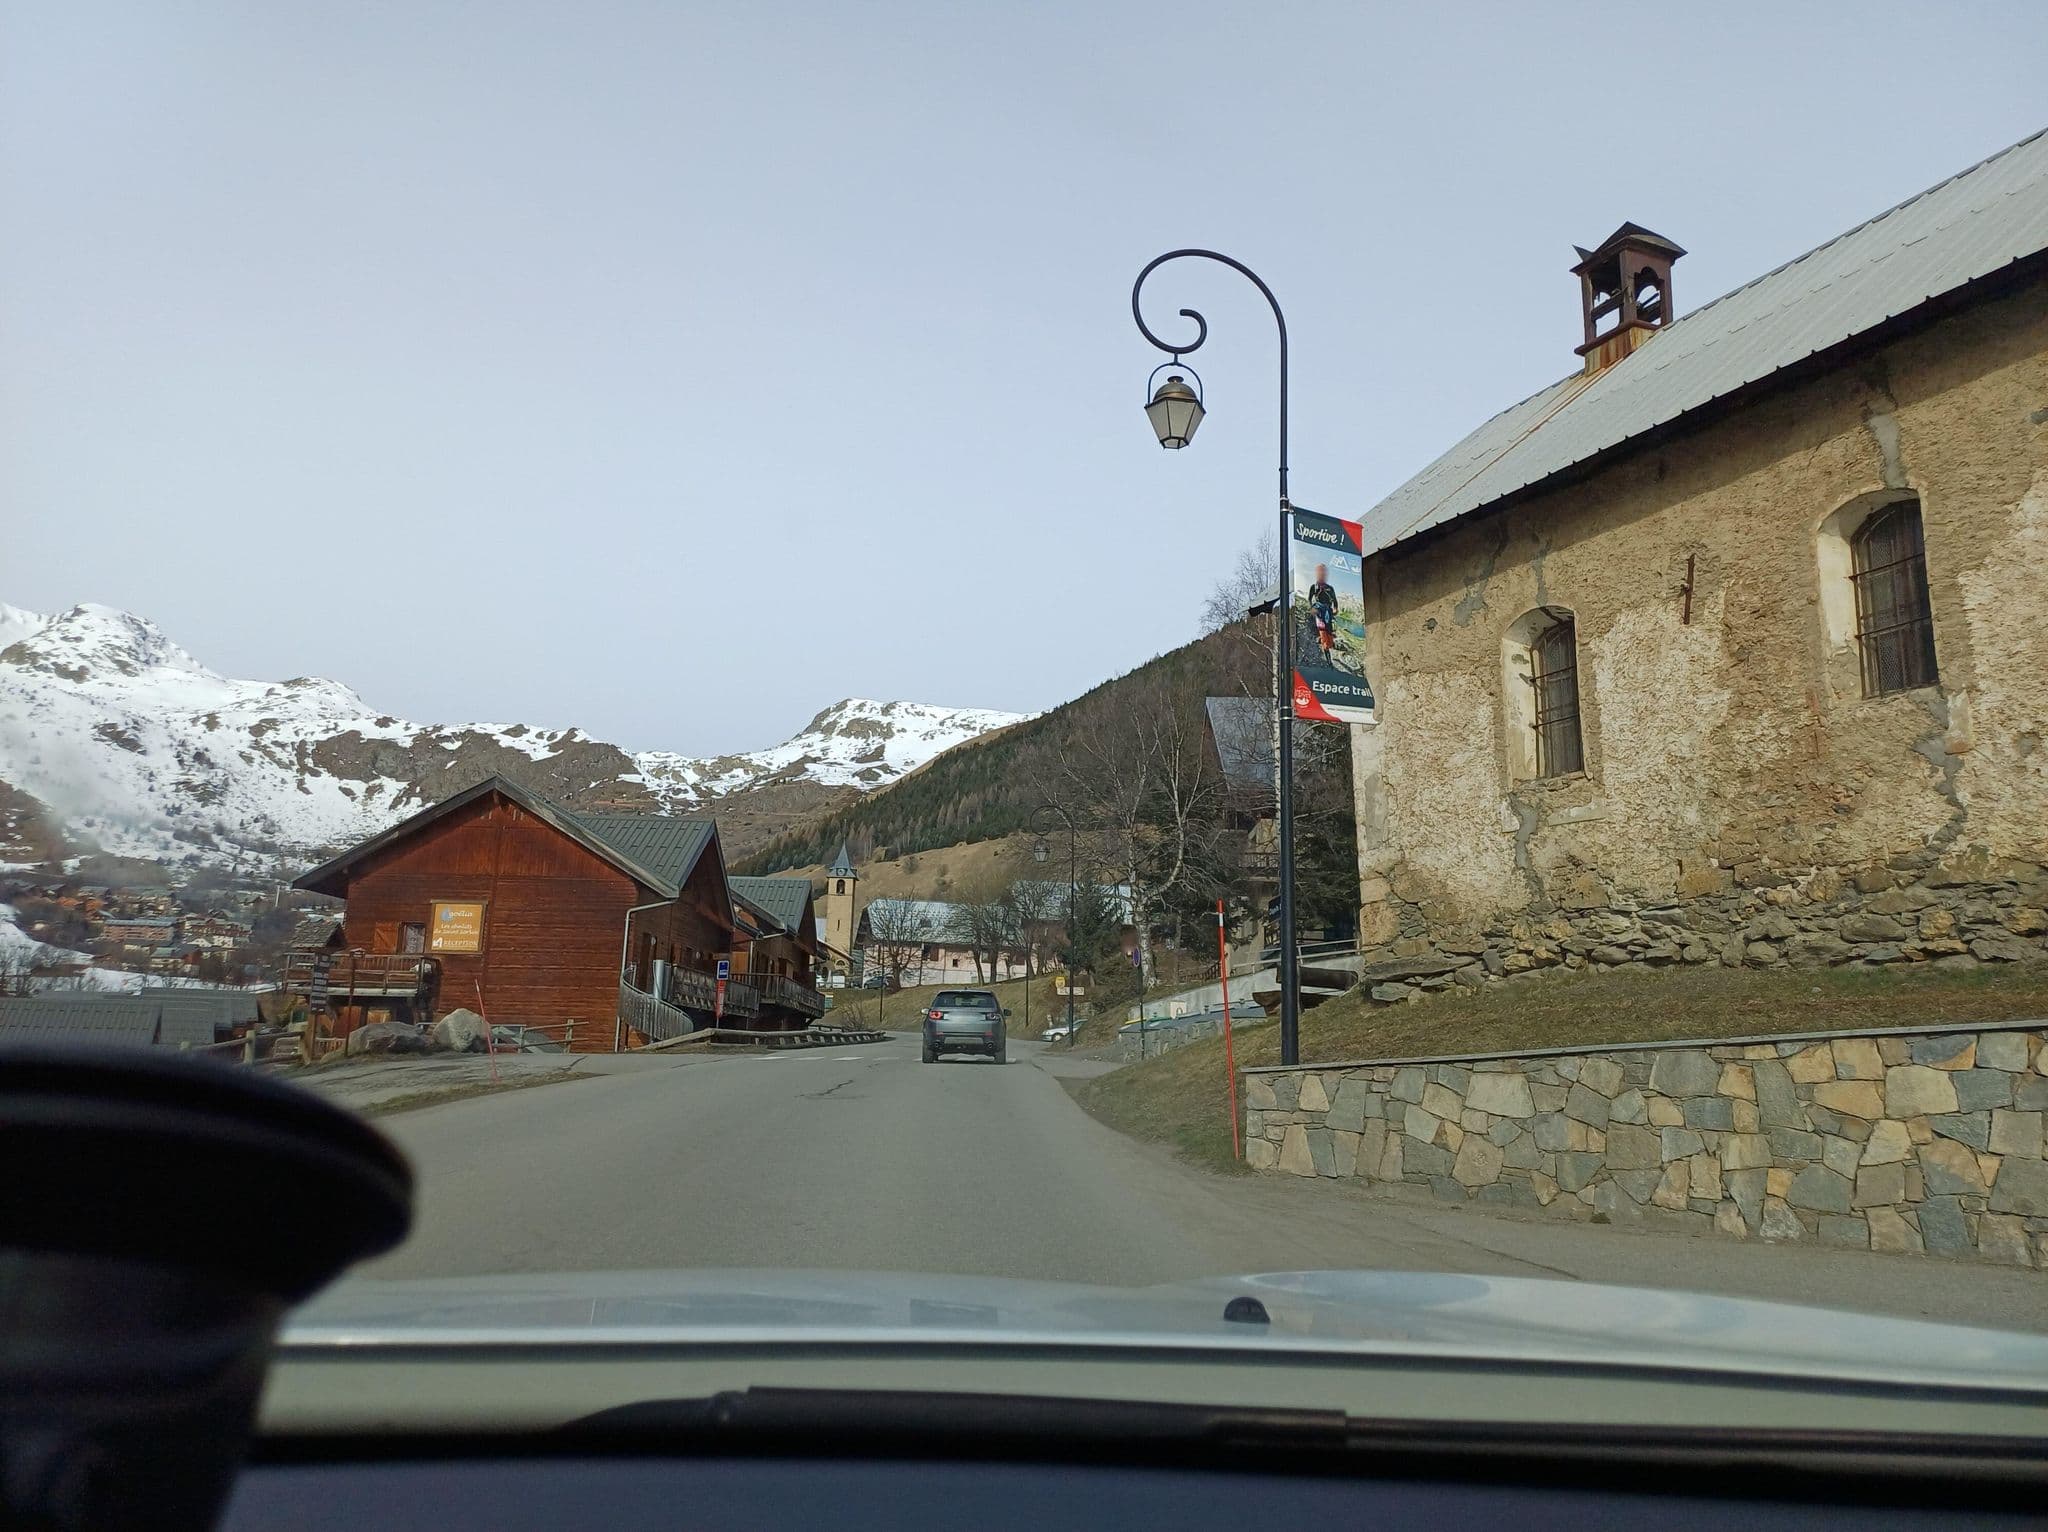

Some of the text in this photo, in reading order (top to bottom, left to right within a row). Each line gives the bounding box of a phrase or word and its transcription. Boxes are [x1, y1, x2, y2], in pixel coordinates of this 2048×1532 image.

[1296, 523, 1345, 546] Sportive !
[1312, 681, 1373, 697] Espace trail
